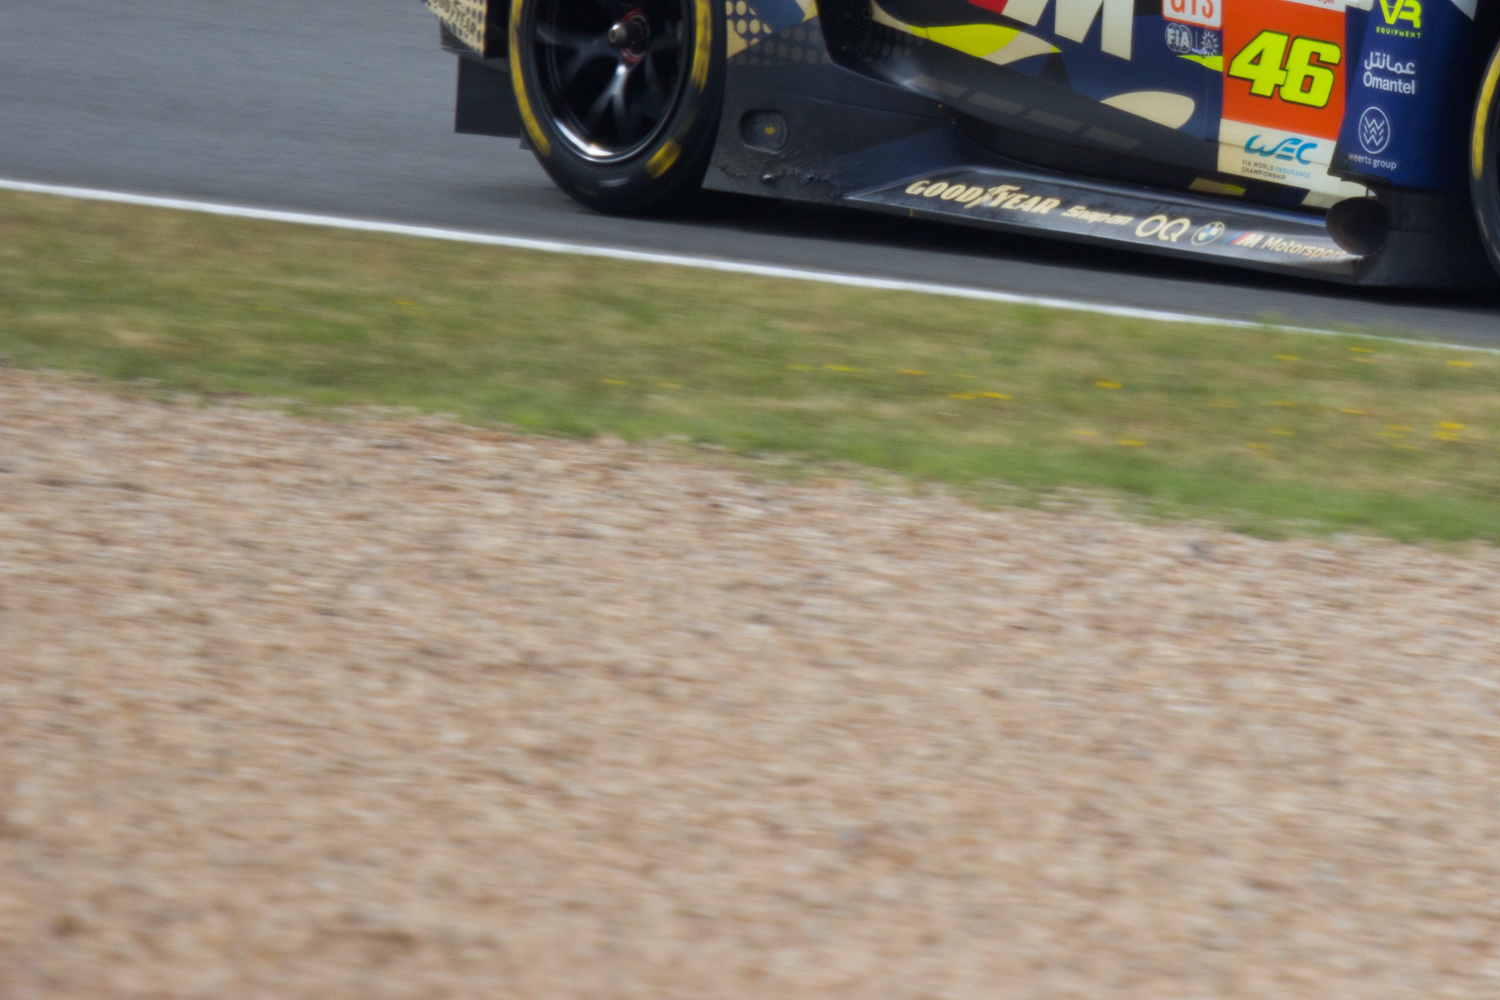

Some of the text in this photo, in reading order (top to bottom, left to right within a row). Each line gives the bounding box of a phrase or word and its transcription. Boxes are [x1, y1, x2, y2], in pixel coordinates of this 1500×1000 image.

[1376, 25, 1422, 39] EQUIPMENT
[1226, 28, 1342, 109] 46
[1363, 51, 1416, 76] عمانتل
[1362, 70, 1416, 95] Omantel
[1243, 134, 1319, 166] WEC
[1348, 152, 1397, 172] weerts group
[1241, 159, 1311, 179] FIA WORLD ENDURANCE
[1241, 166, 1287, 181] CHAMPIONSHIP
[1134, 214, 1192, 243] OQ
